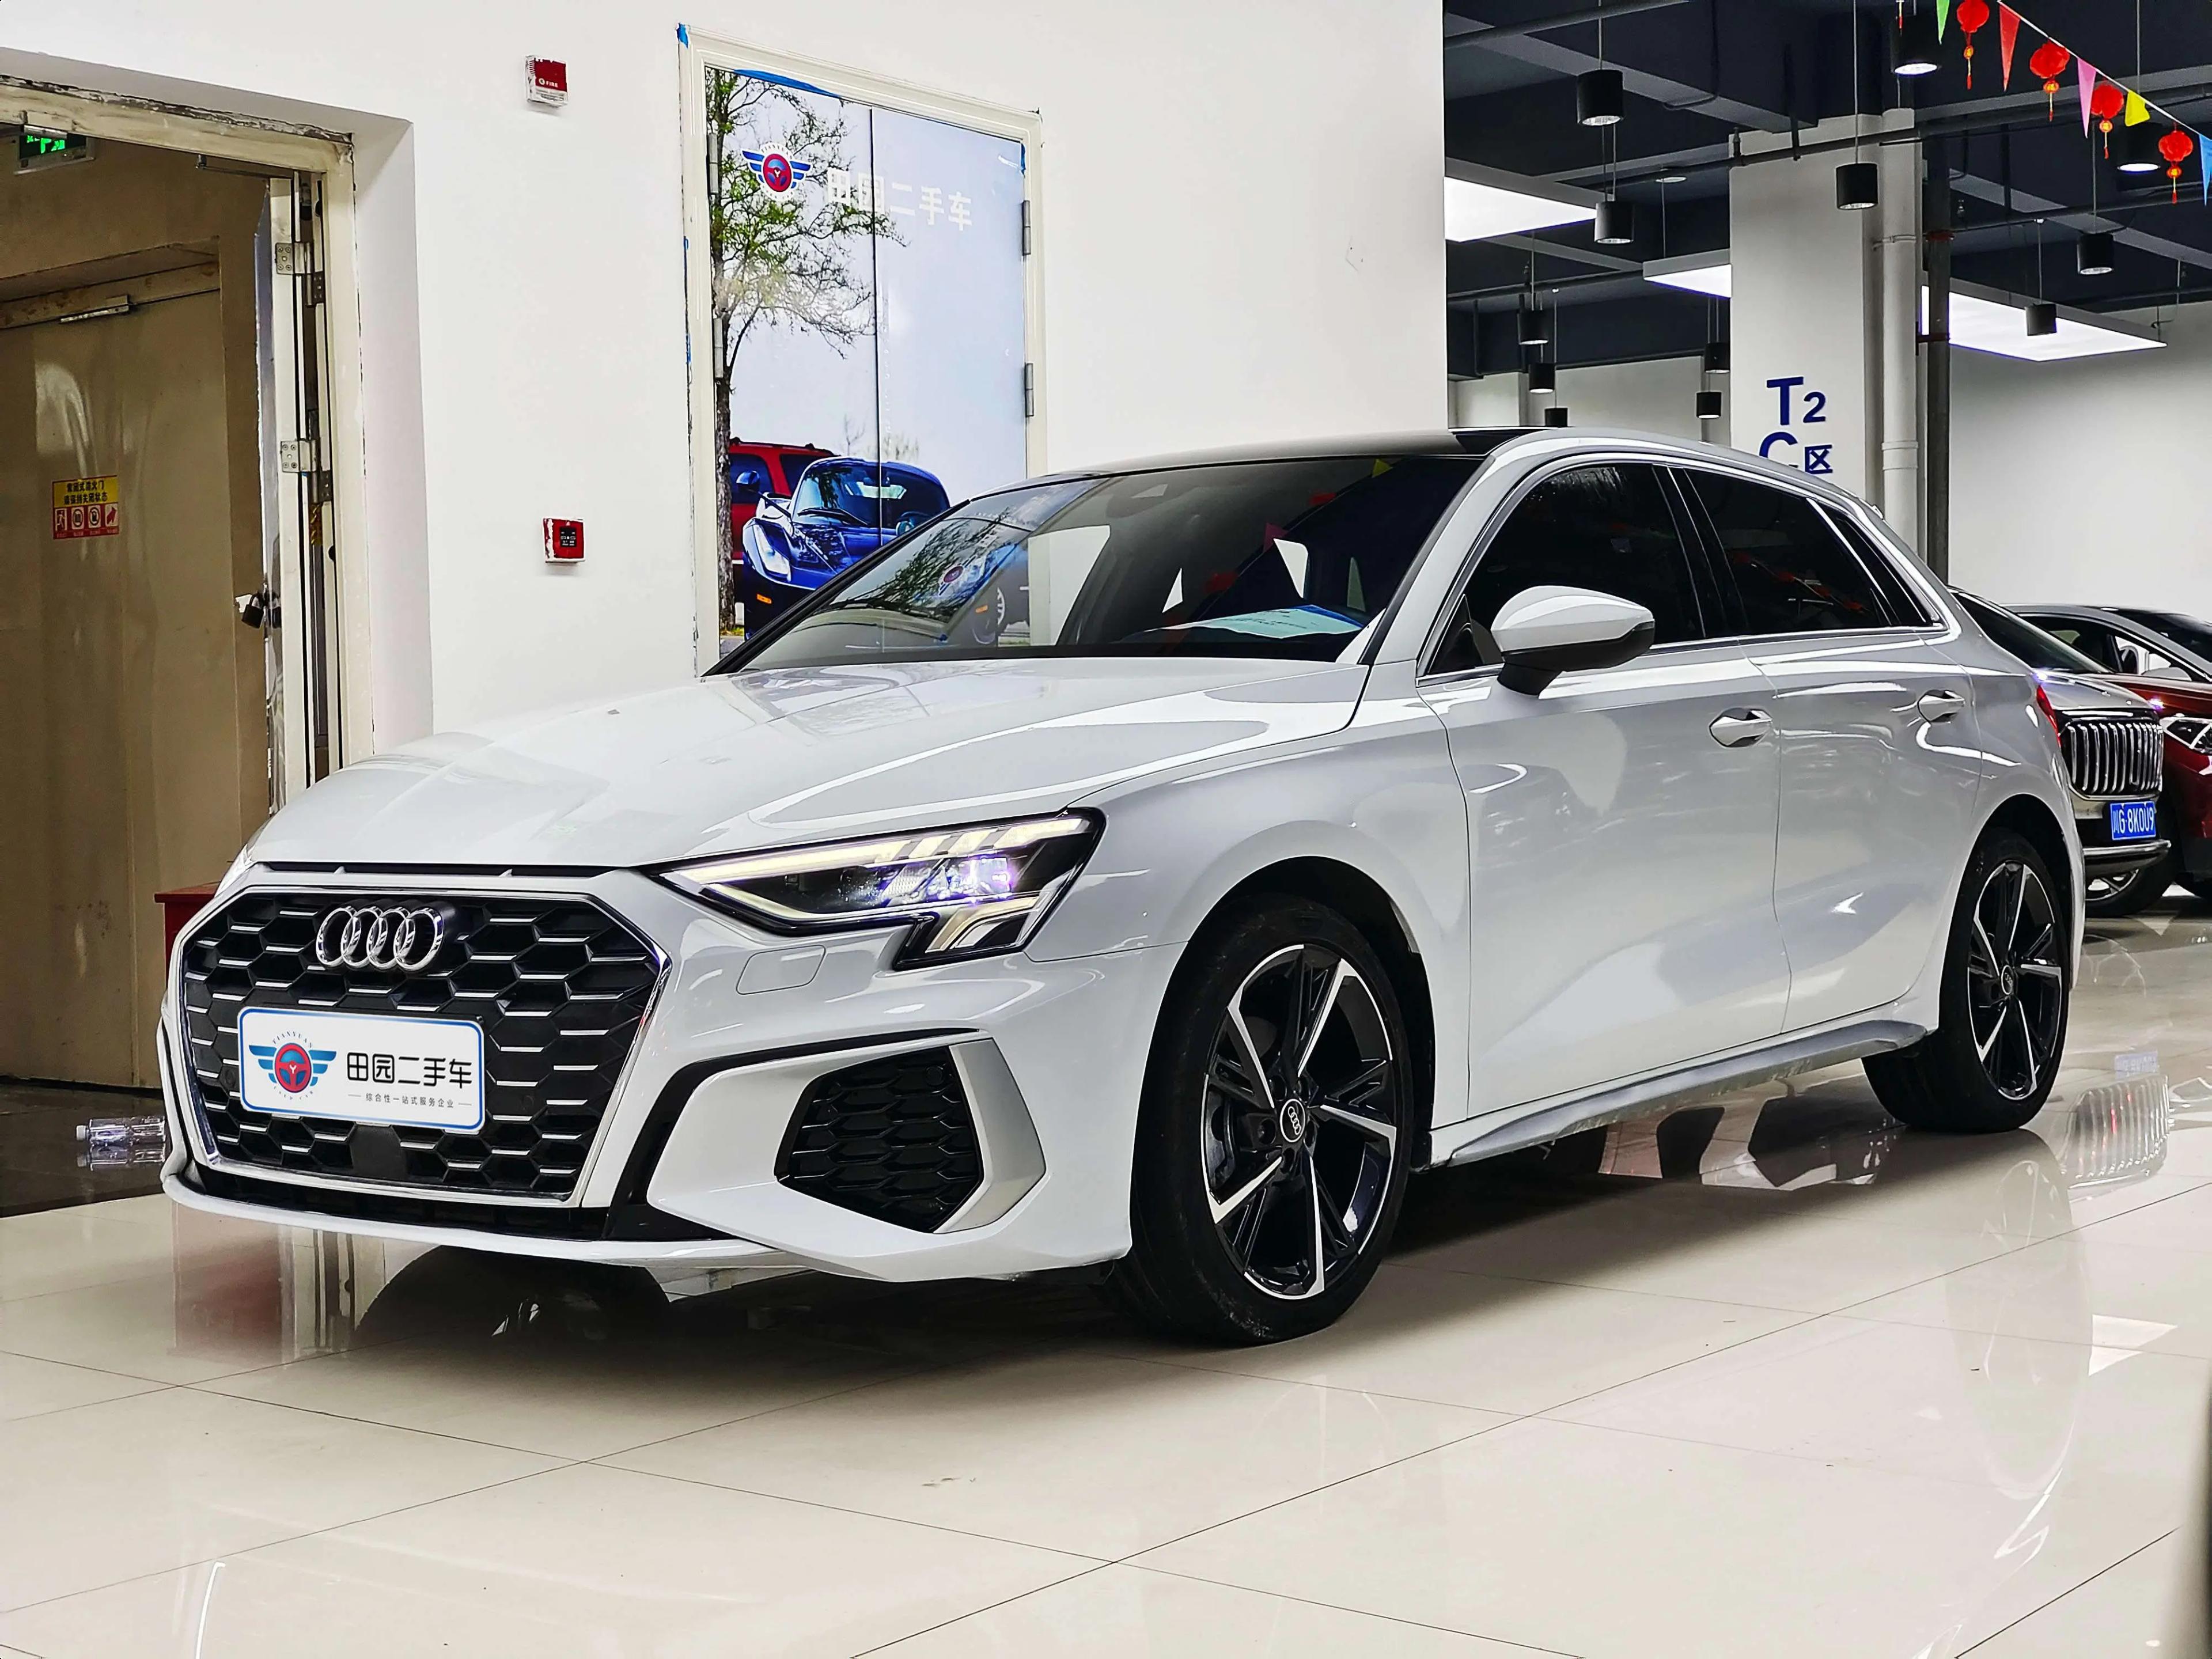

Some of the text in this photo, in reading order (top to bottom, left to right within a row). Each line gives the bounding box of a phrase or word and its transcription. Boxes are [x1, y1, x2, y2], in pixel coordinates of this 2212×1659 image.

[827, 166, 972, 231] 田园二手车
[1766, 376, 1826, 426] T2
[347, 1052, 472, 1089] 田园二手车
[366, 1092, 454, 1108] 综合性一站式服务企业
